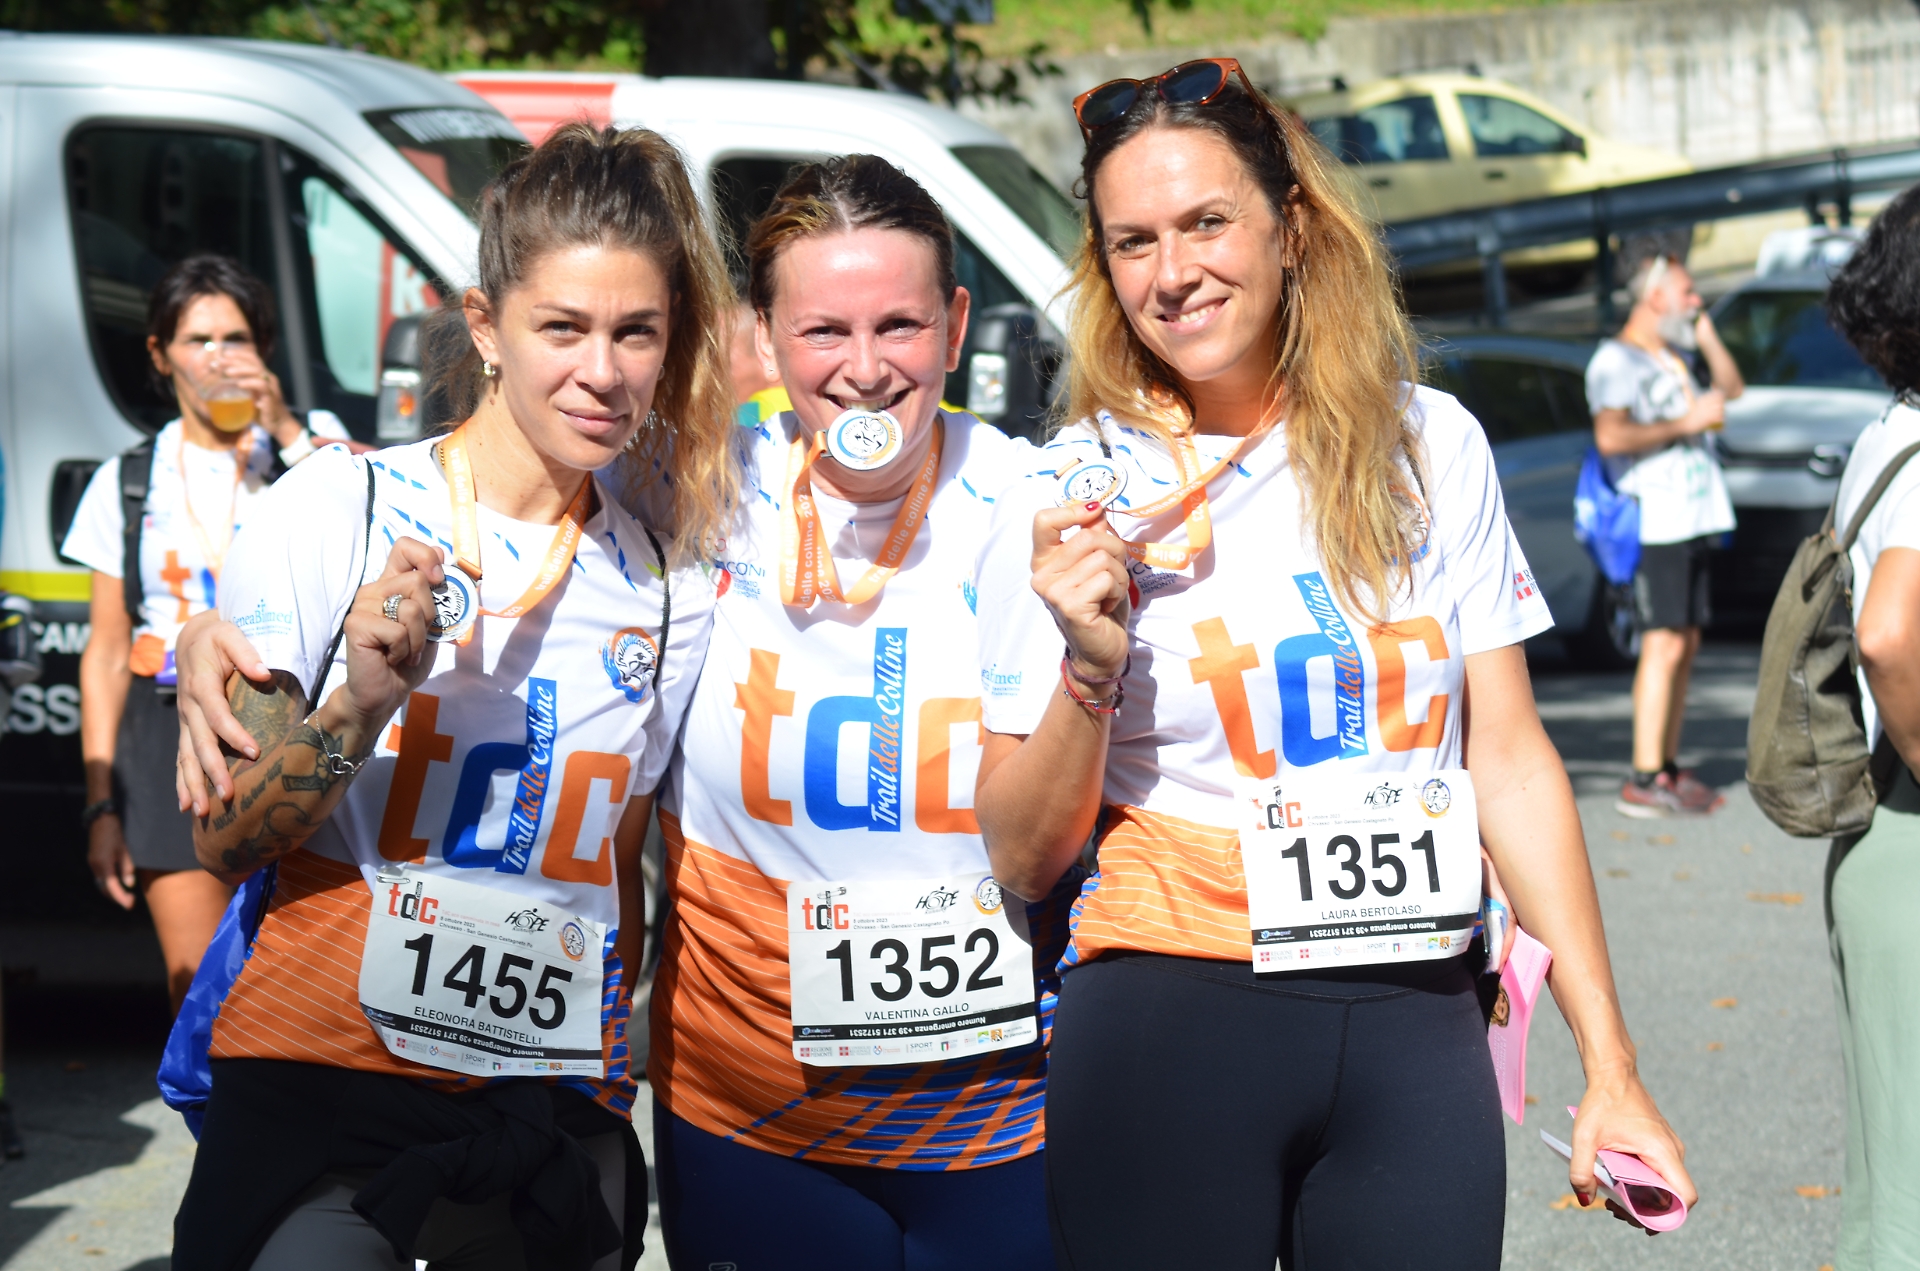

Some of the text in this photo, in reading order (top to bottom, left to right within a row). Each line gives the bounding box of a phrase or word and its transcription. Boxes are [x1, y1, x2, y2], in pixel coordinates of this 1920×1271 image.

[450, 447, 465, 474] trail
[454, 475, 469, 503] delle
[868, 452, 938, 583] trail delle colline 2023
[1139, 497, 1178, 515] colline
[1189, 493, 1205, 522] 2023
[534, 573, 555, 591] trail
[548, 543, 568, 573] delle
[562, 510, 582, 546] colline
[797, 485, 814, 603] delle colline 2023
[1151, 548, 1186, 564] delle
[726, 561, 766, 578] CONI
[1188, 571, 1450, 781] tdc
[733, 627, 985, 835] tdc
[377, 676, 632, 887] tdc
[1281, 830, 1441, 901] 1351
[388, 881, 439, 925] tdc
[505, 911, 550, 932] HOPE
[802, 890, 849, 931] tdc
[915, 890, 959, 910] HOPE
[1321, 908, 1358, 921] LAURA
[1360, 905, 1422, 918] BERTOLASO
[439, 923, 462, 932] Chivasso
[477, 930, 497, 940] Genesio
[499, 935, 526, 948] Castagneto
[444, 918, 462, 926] ottobre
[463, 921, 476, 929] 2023
[913, 920, 942, 928] Castagneto
[1309, 929, 1339, 938] 5172531
[1355, 926, 1369, 934] +39
[1370, 923, 1408, 932] emergenza
[1409, 921, 1437, 930] Numero
[826, 927, 1003, 1002] 1352
[404, 933, 573, 1030] 1455
[865, 1008, 929, 1021] VALENTINA
[933, 1002, 970, 1017] GALLO
[957, 1016, 986, 1028] Numero
[414, 1006, 476, 1029] ELEONORA
[478, 1021, 542, 1046] BATTISTELLI
[898, 1028, 912, 1036] +39
[914, 1020, 956, 1033] emergenza
[410, 1023, 545, 1058] Numero emergenza +39 371 5172531
[465, 1053, 487, 1065] SPORT
